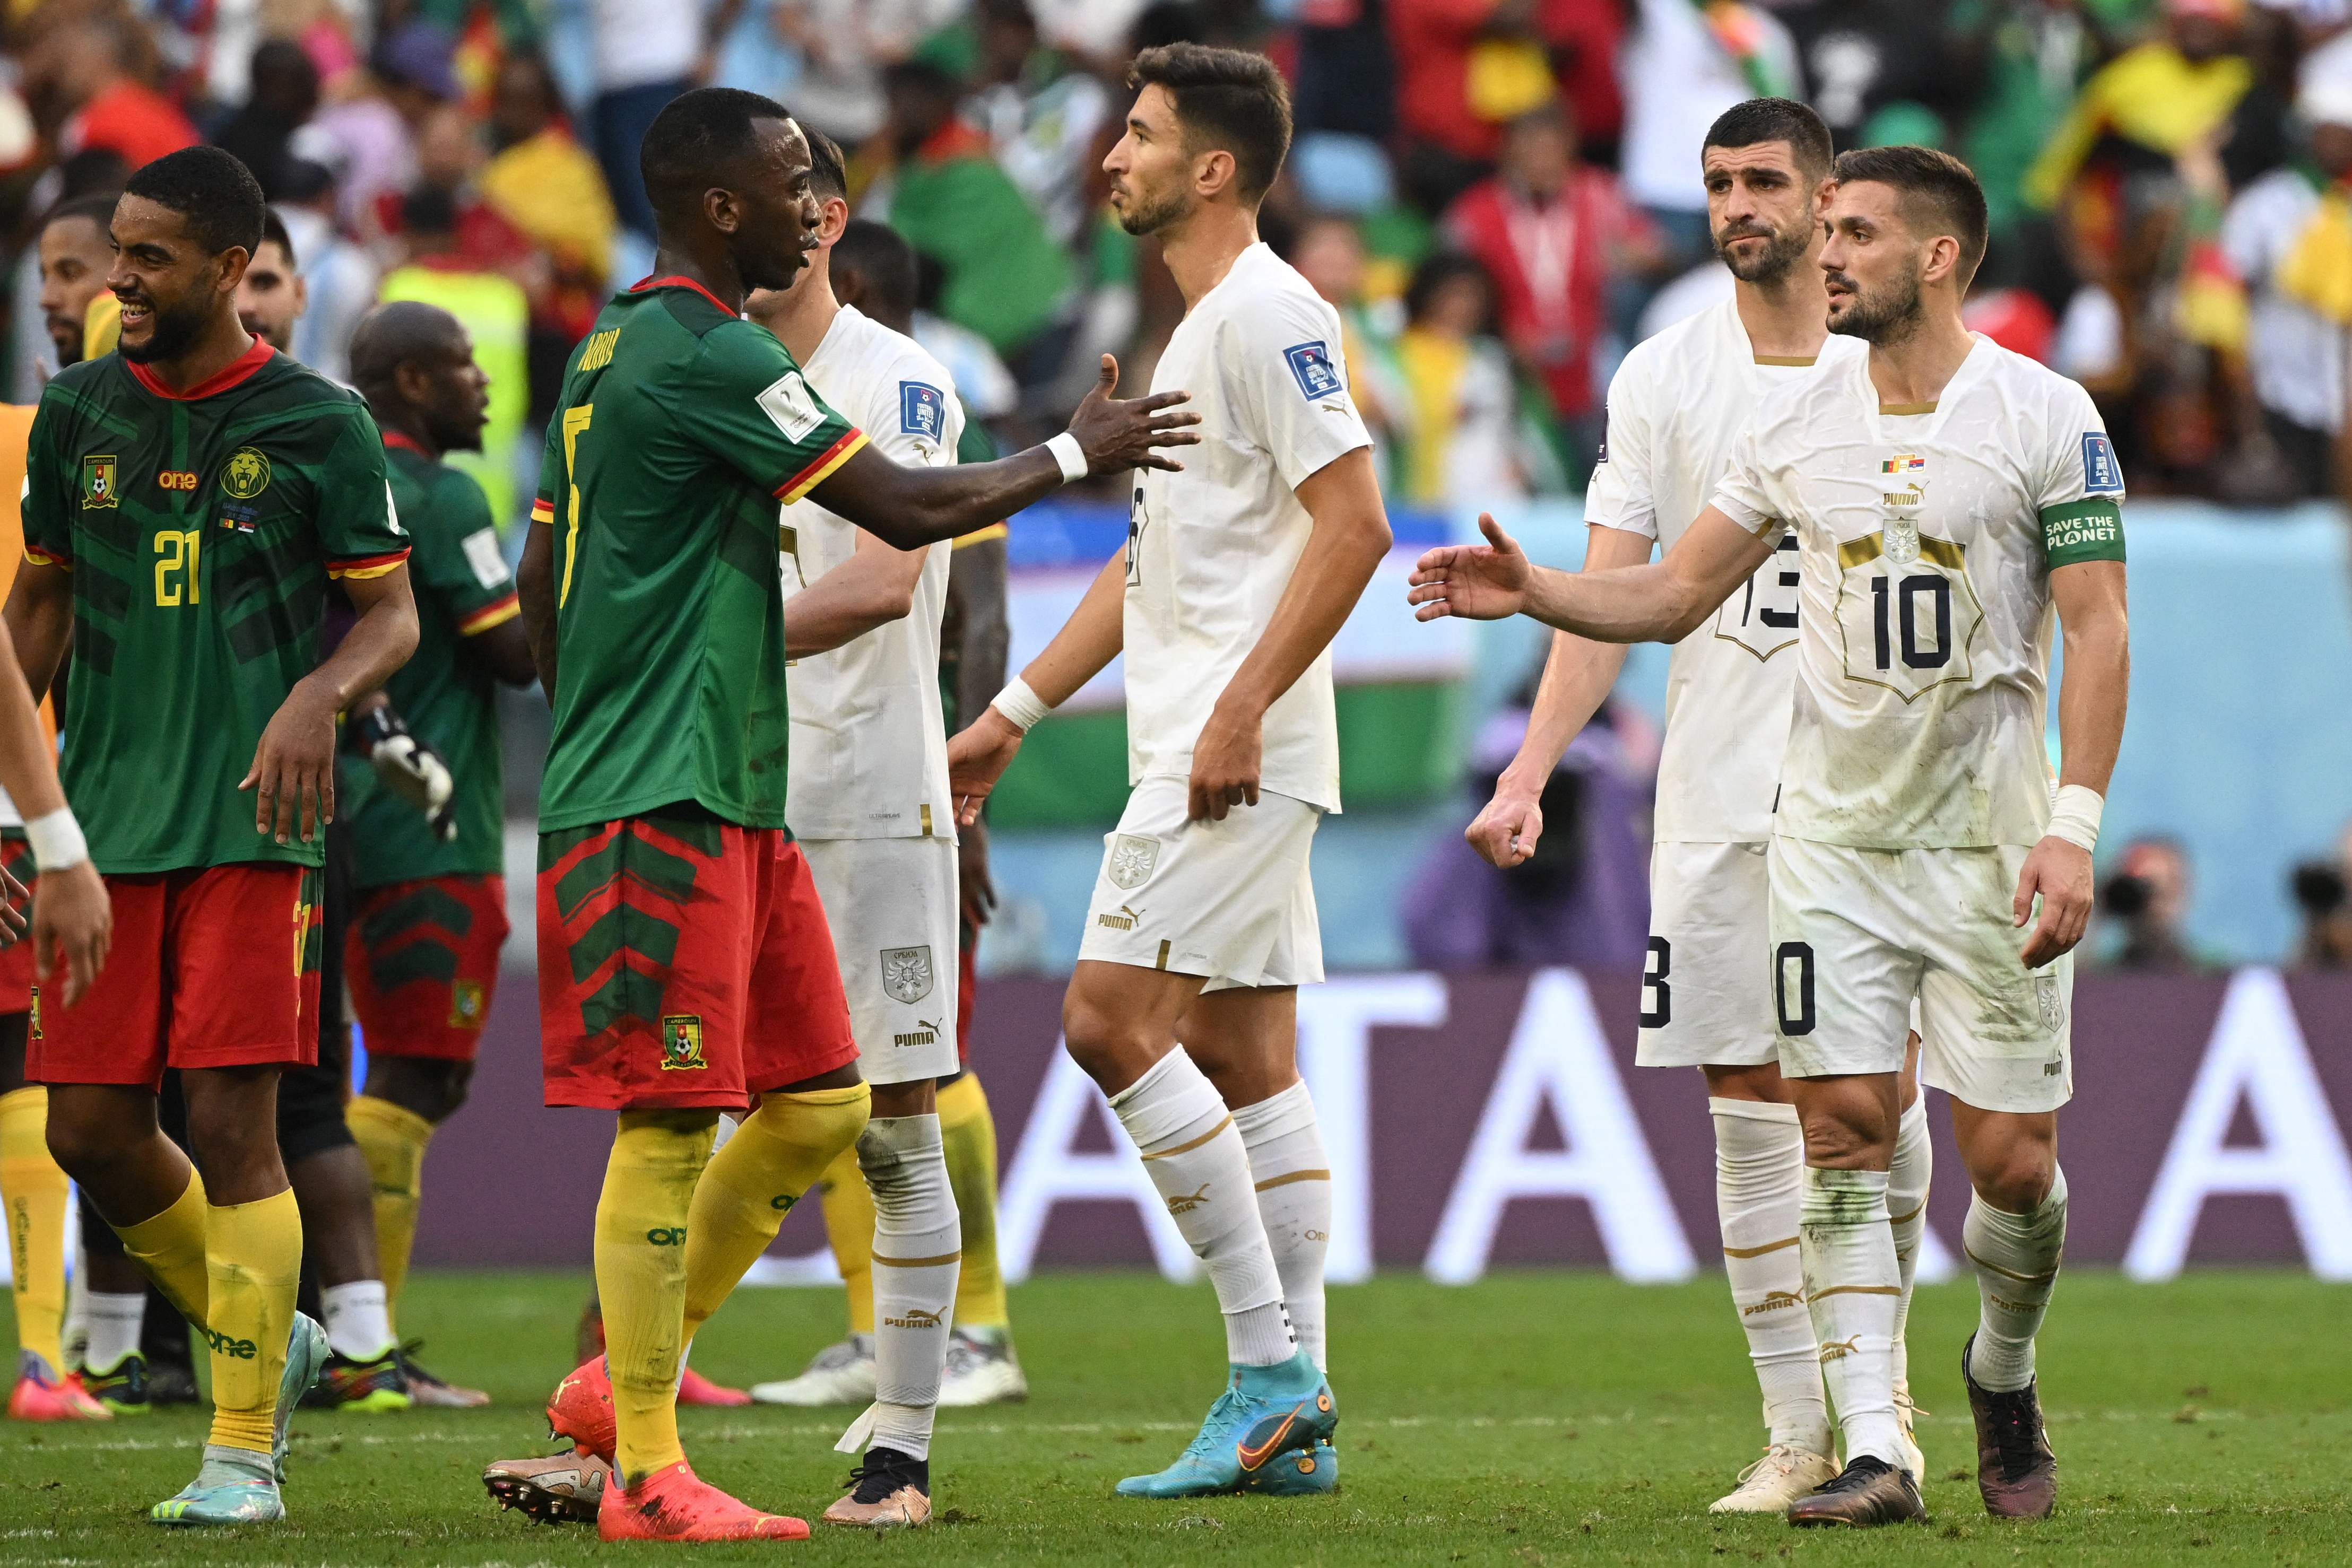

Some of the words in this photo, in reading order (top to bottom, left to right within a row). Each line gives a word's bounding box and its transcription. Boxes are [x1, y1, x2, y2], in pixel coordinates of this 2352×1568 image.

[159, 472, 197, 490] one
[1884, 493, 1919, 506] PUMA
[2045, 517, 2083, 537] SAVE
[2085, 516, 2115, 528] THE
[2047, 527, 2116, 551] PLANET
[154, 530, 200, 606] 21
[1871, 574, 1951, 669] 10
[1097, 913, 1133, 931] PUMA
[893, 951, 918, 960] СРБИЈА
[1770, 942, 1816, 1036] 0
[893, 1031, 934, 1048] PUMA
[646, 1227, 688, 1247] on
[1744, 1298, 1794, 1316] PUMA
[884, 1317, 933, 1328] PUMA
